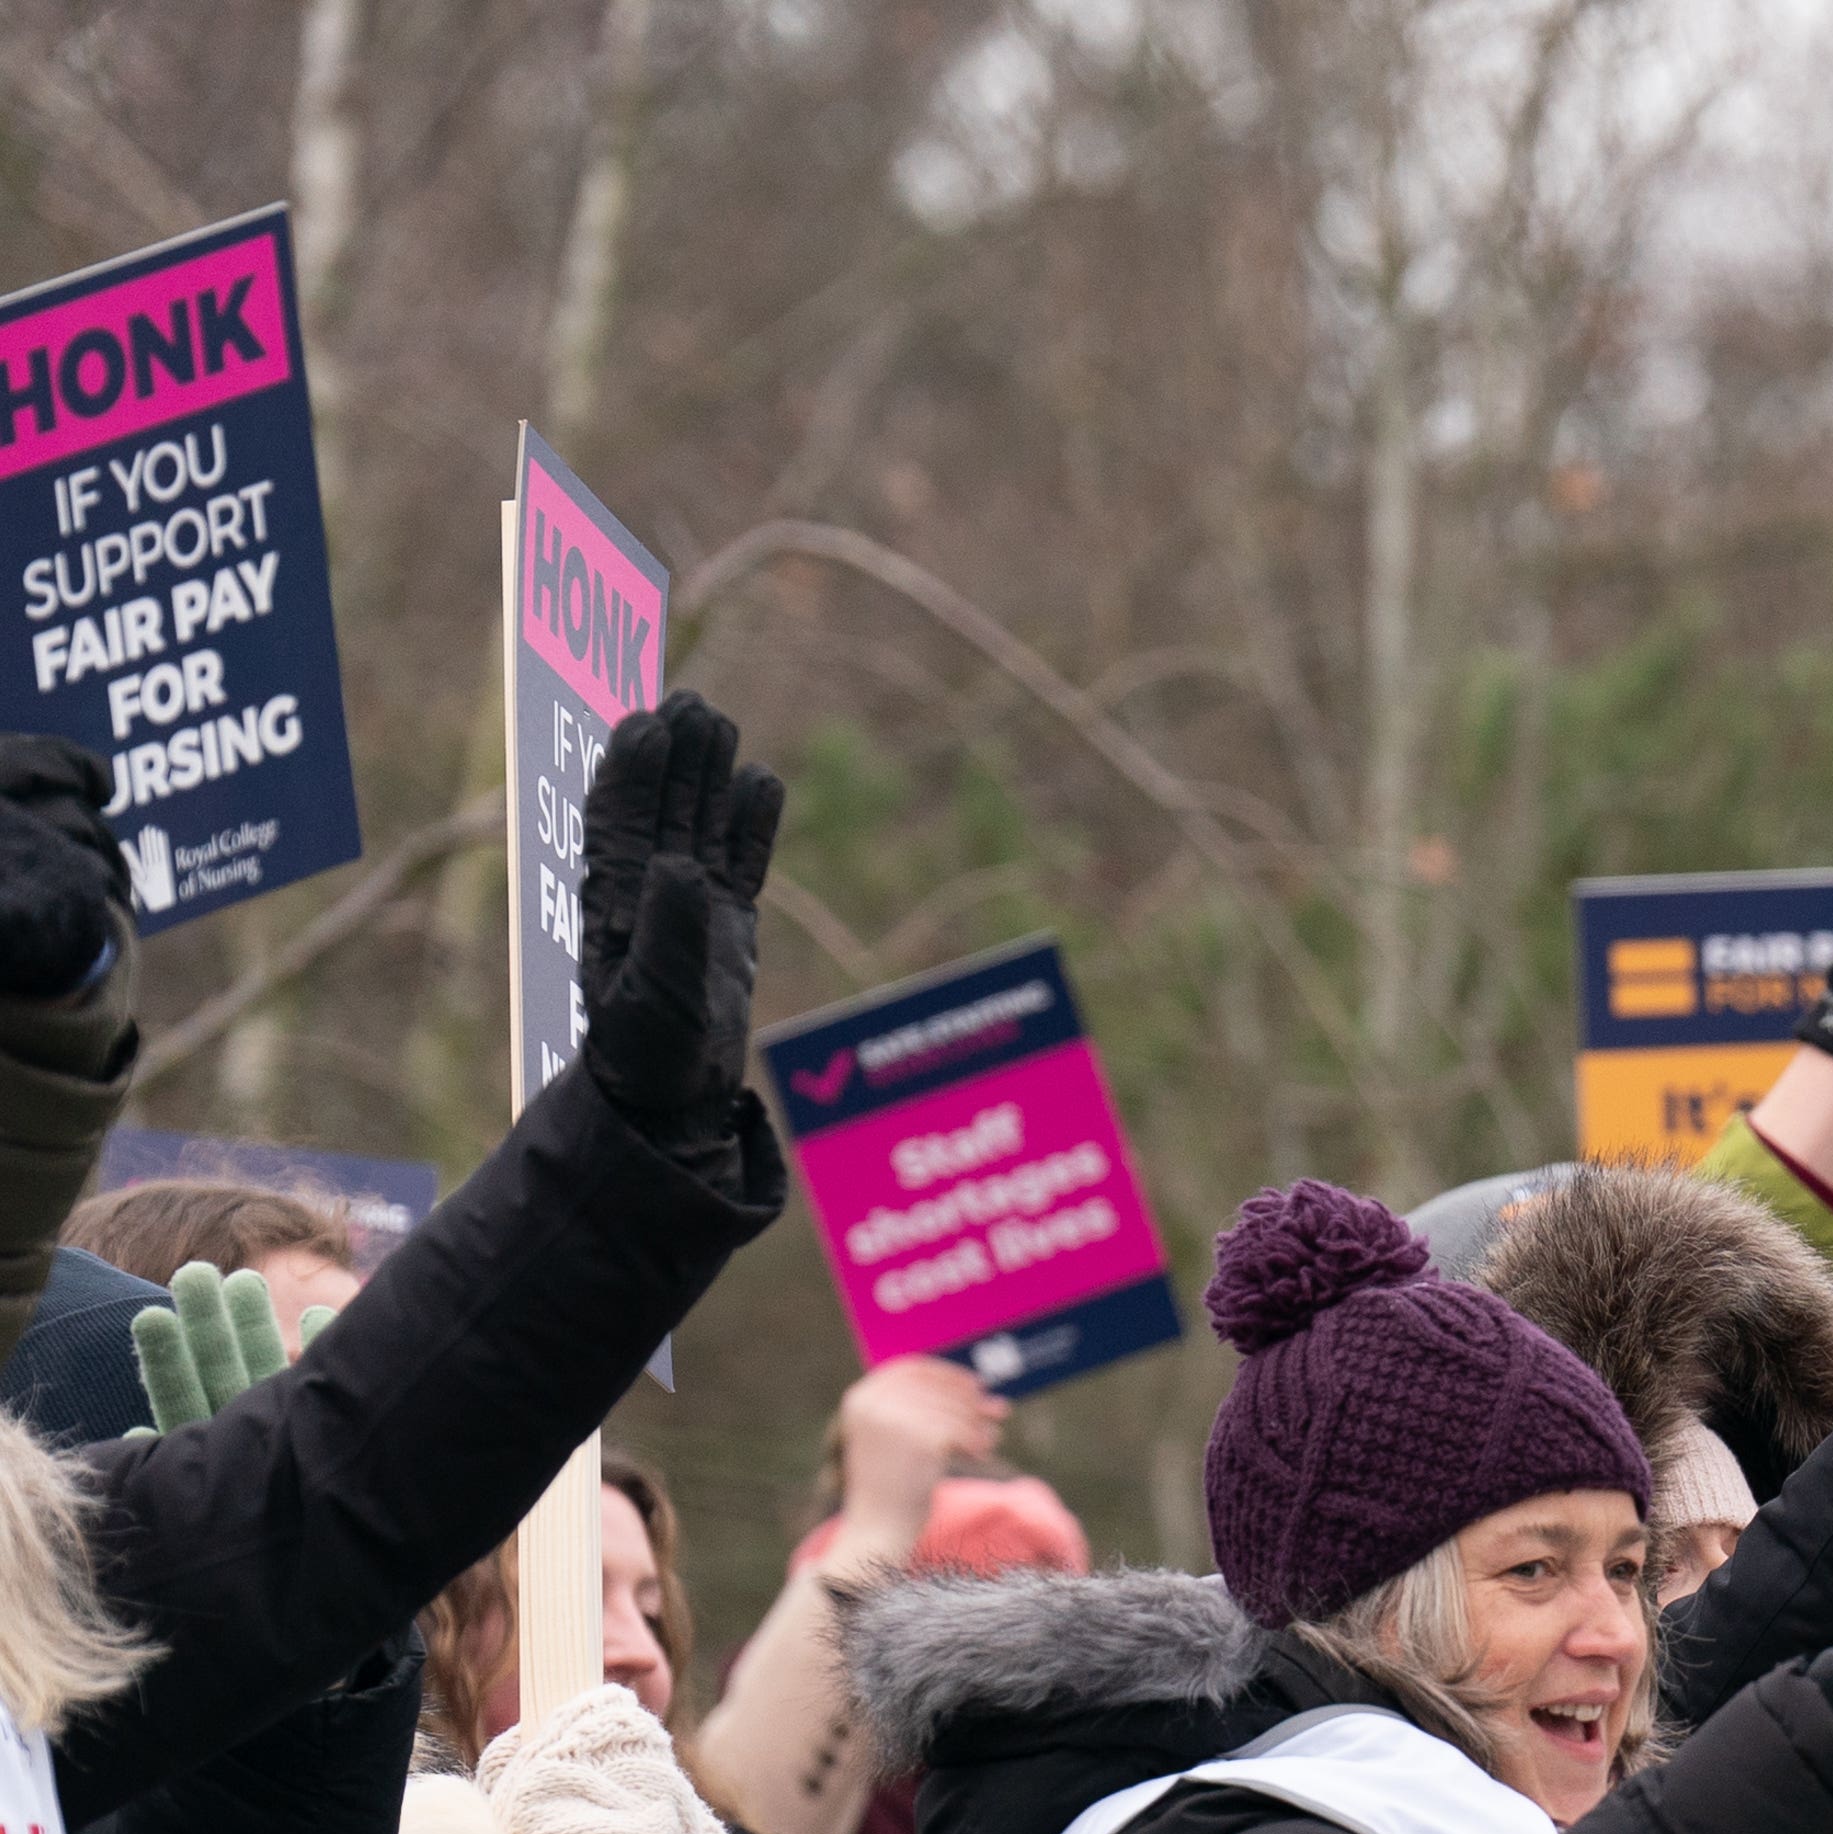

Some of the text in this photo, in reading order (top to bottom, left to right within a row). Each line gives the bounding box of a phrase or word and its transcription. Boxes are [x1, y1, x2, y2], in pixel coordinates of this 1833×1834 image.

[0, 275, 267, 448] HONK
[53, 423, 227, 538] IF YOU
[22, 479, 275, 619] SUPPORT
[532, 506, 650, 711] HONK
[31, 550, 280, 692] FAIR PAY
[100, 693, 303, 818] URSING
[107, 649, 227, 740] FOR
[552, 699, 576, 776] IF
